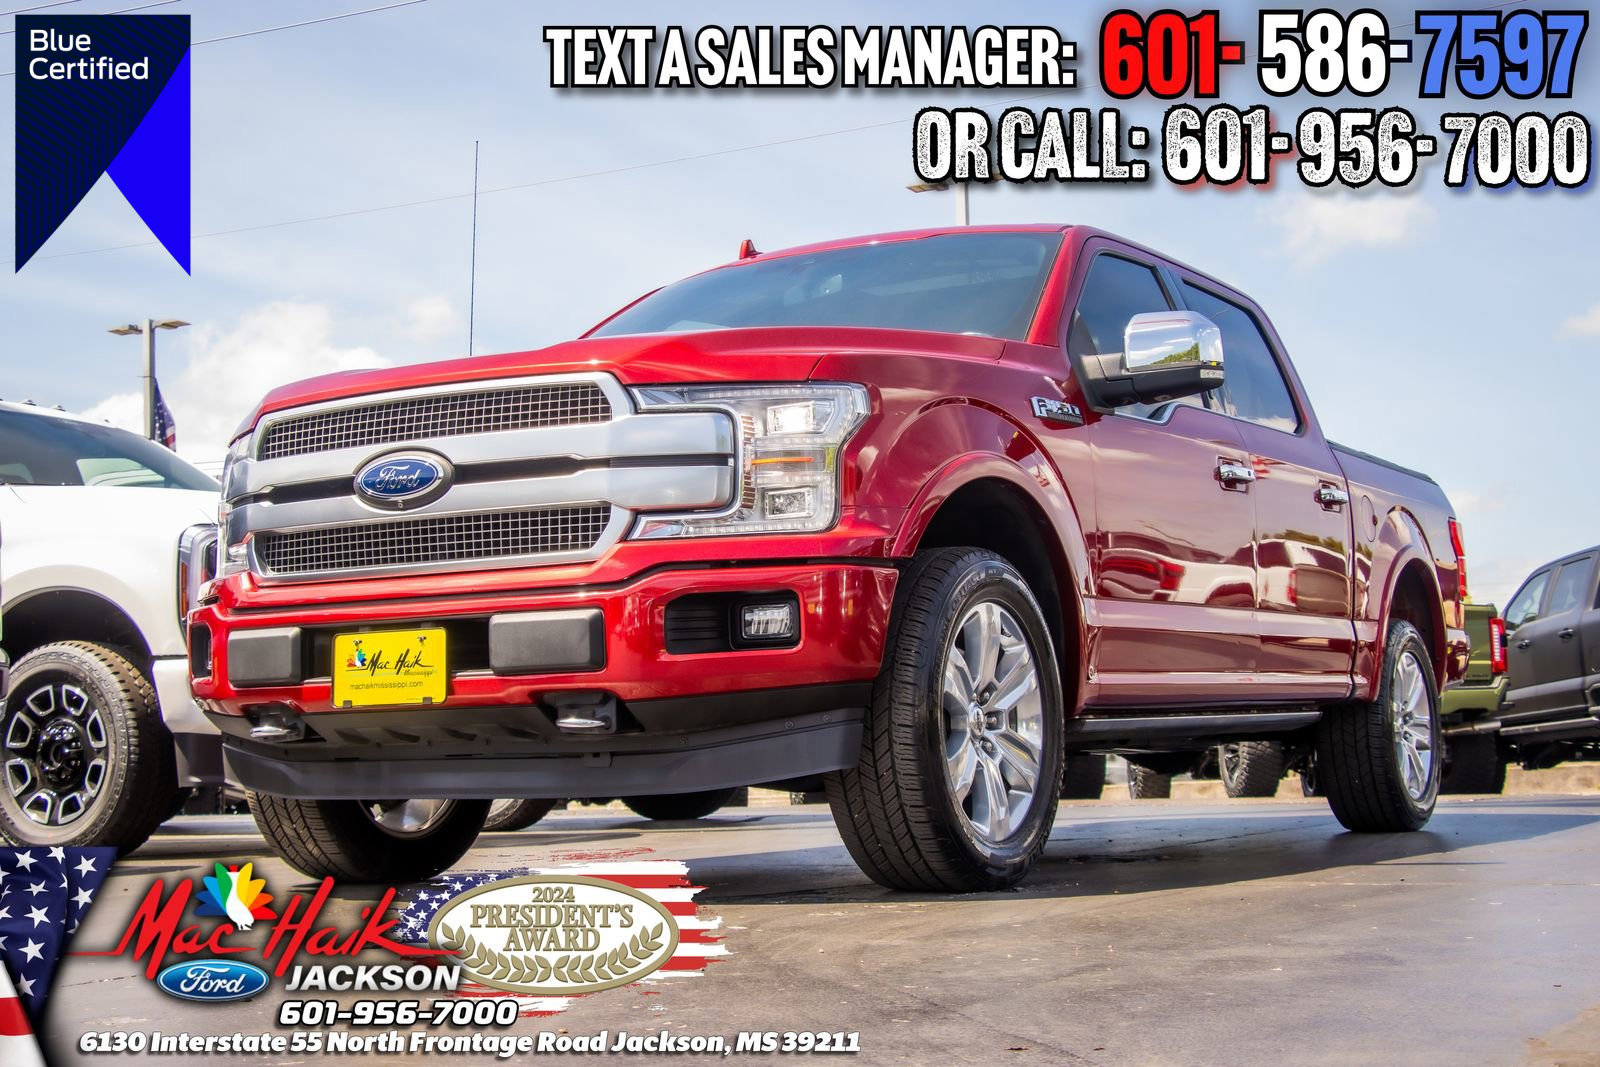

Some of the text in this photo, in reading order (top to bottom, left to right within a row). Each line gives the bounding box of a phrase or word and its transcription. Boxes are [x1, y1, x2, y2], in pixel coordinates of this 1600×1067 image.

[375, 465, 421, 491] Ford
[361, 648, 430, 677] Mac Haik
[349, 680, 424, 691] machaikmississippi.com
